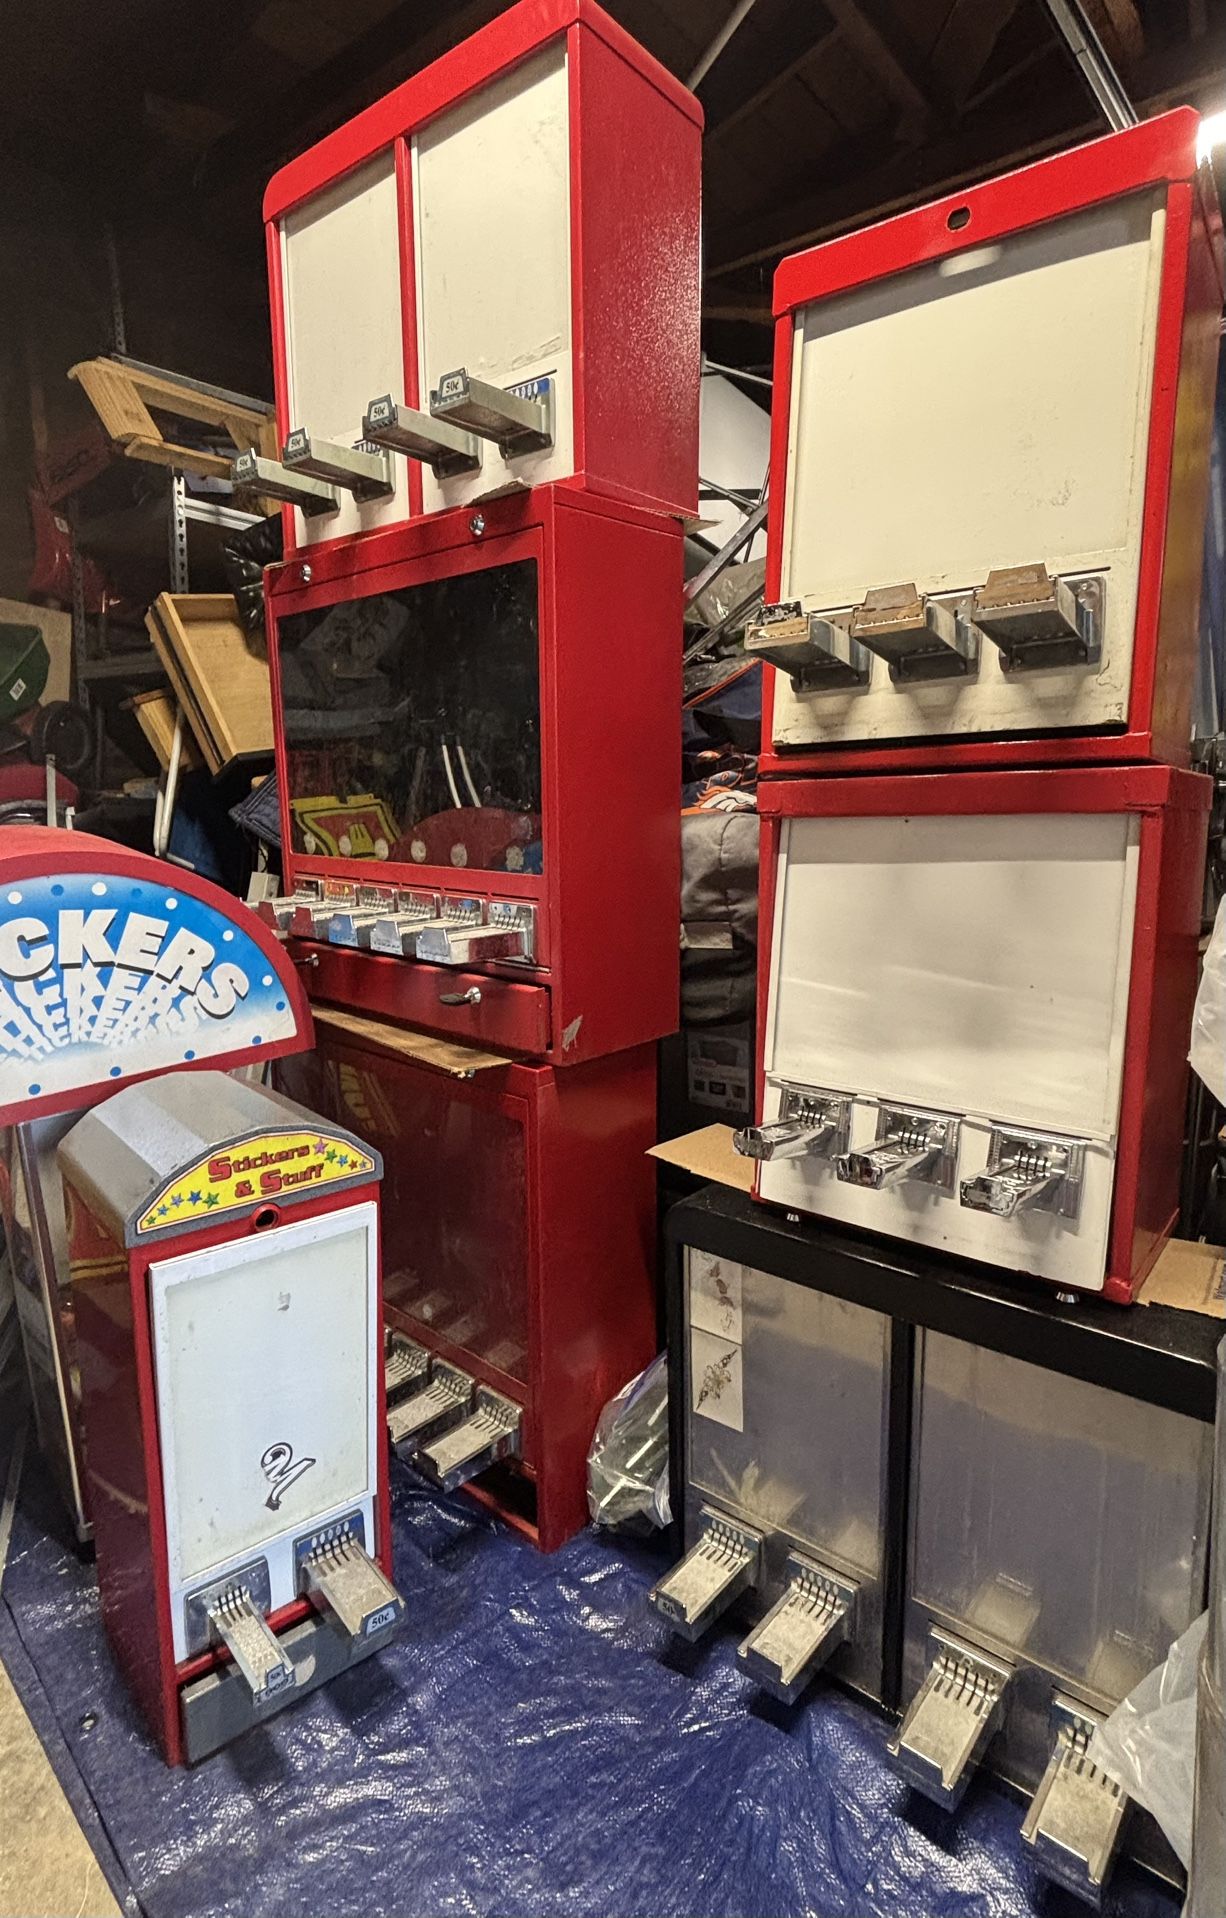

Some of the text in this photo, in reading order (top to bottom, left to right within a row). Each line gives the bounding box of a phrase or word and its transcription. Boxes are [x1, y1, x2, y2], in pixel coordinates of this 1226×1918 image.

[445, 380, 459, 394] 50¢
[208, 1145, 310, 1183] Stickers
[235, 1163, 325, 1198] & Stuff
